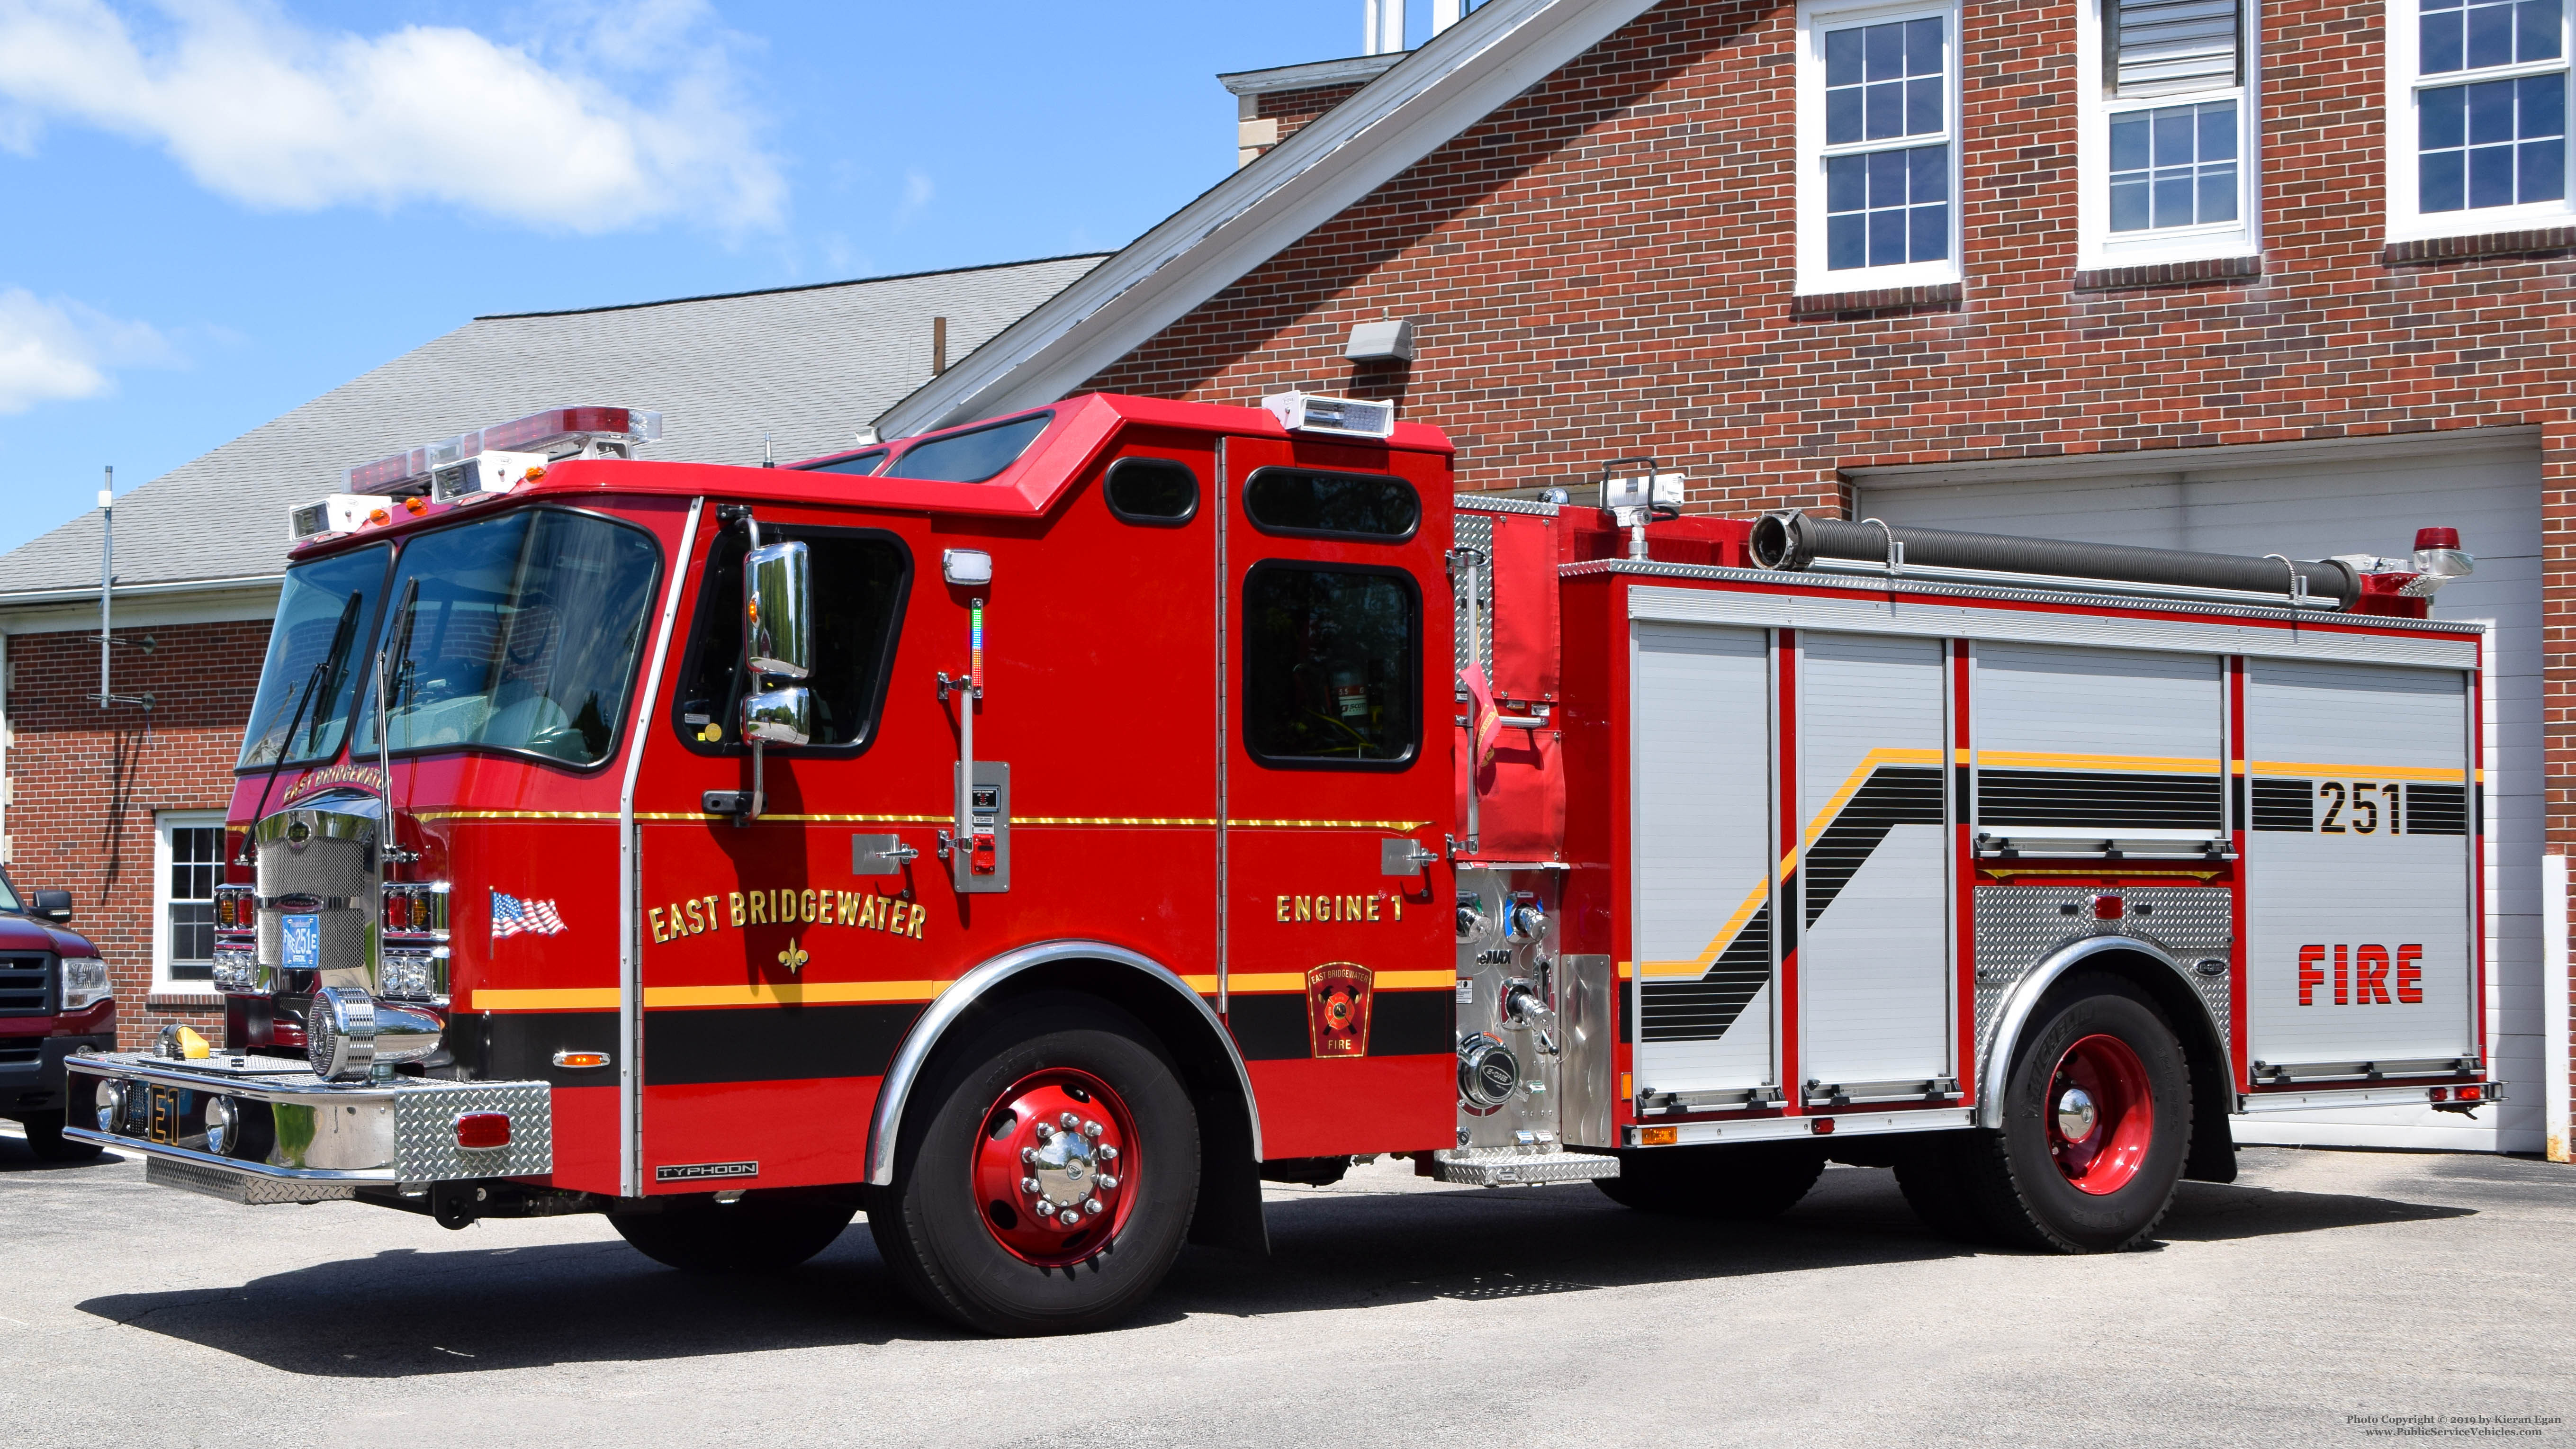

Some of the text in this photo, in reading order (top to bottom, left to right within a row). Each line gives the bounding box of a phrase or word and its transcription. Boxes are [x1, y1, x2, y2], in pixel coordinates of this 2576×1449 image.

[284, 773, 315, 802] EAST
[2319, 781, 2402, 836] 251
[649, 889, 927, 944] EAST BRIDGEWATER
[1277, 895, 1401, 921] ENGINE 1
[1479, 949, 1513, 965] eMAX
[1311, 969, 1369, 984] EAST BRIDGEWATER
[2298, 944, 2423, 1006] FIRE
[1328, 1039, 1351, 1050] FIRE
[1486, 1068, 1509, 1083] E-ONE
[151, 1084, 179, 1146] E1
[659, 1164, 755, 1176] TYPHOON
